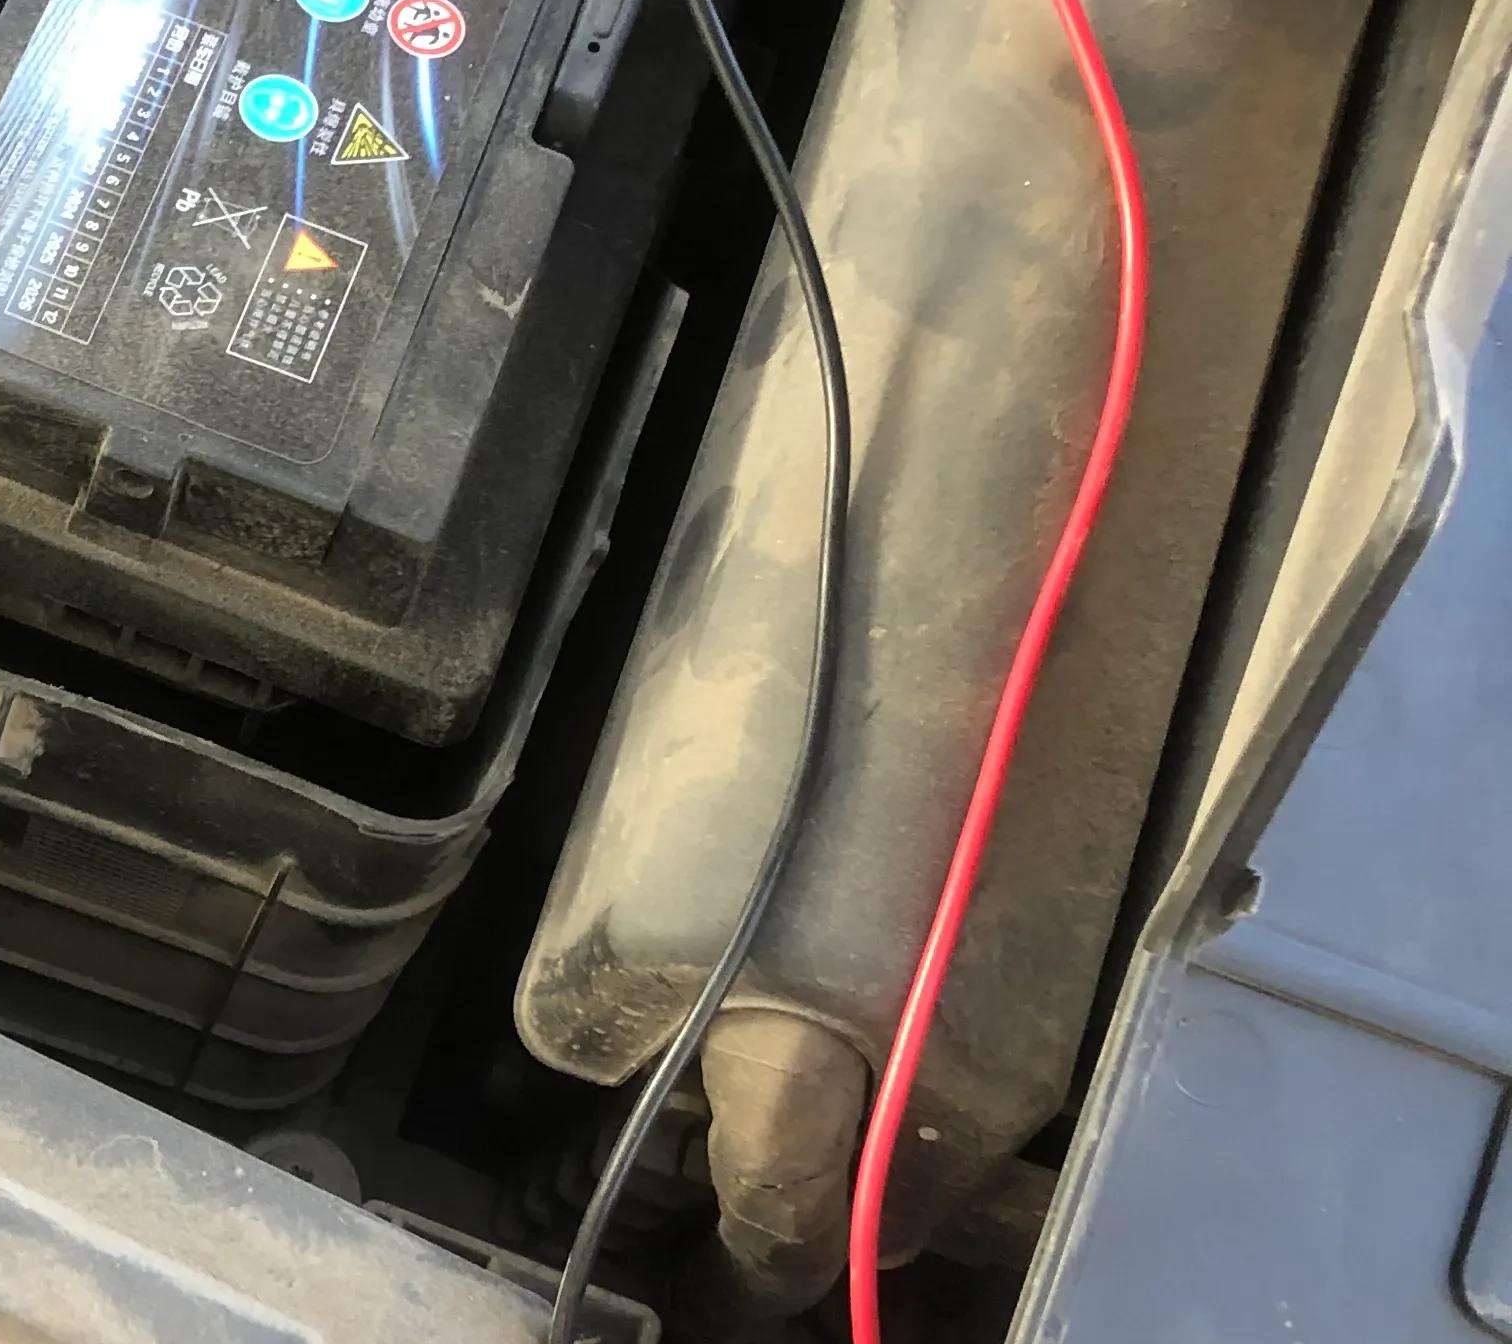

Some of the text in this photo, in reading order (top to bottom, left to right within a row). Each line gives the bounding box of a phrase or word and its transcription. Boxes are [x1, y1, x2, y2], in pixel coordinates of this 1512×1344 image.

[182, 30, 219, 87] 装车日期
[40, 23, 190, 326] 月份 1 2 3 4 5 6 7 8 9 10 11 12
[173, 186, 201, 215] Pb
[37, 230, 65, 266] 2025
[16, 276, 43, 313] 2026
[142, 261, 165, 298] RECYCLE
